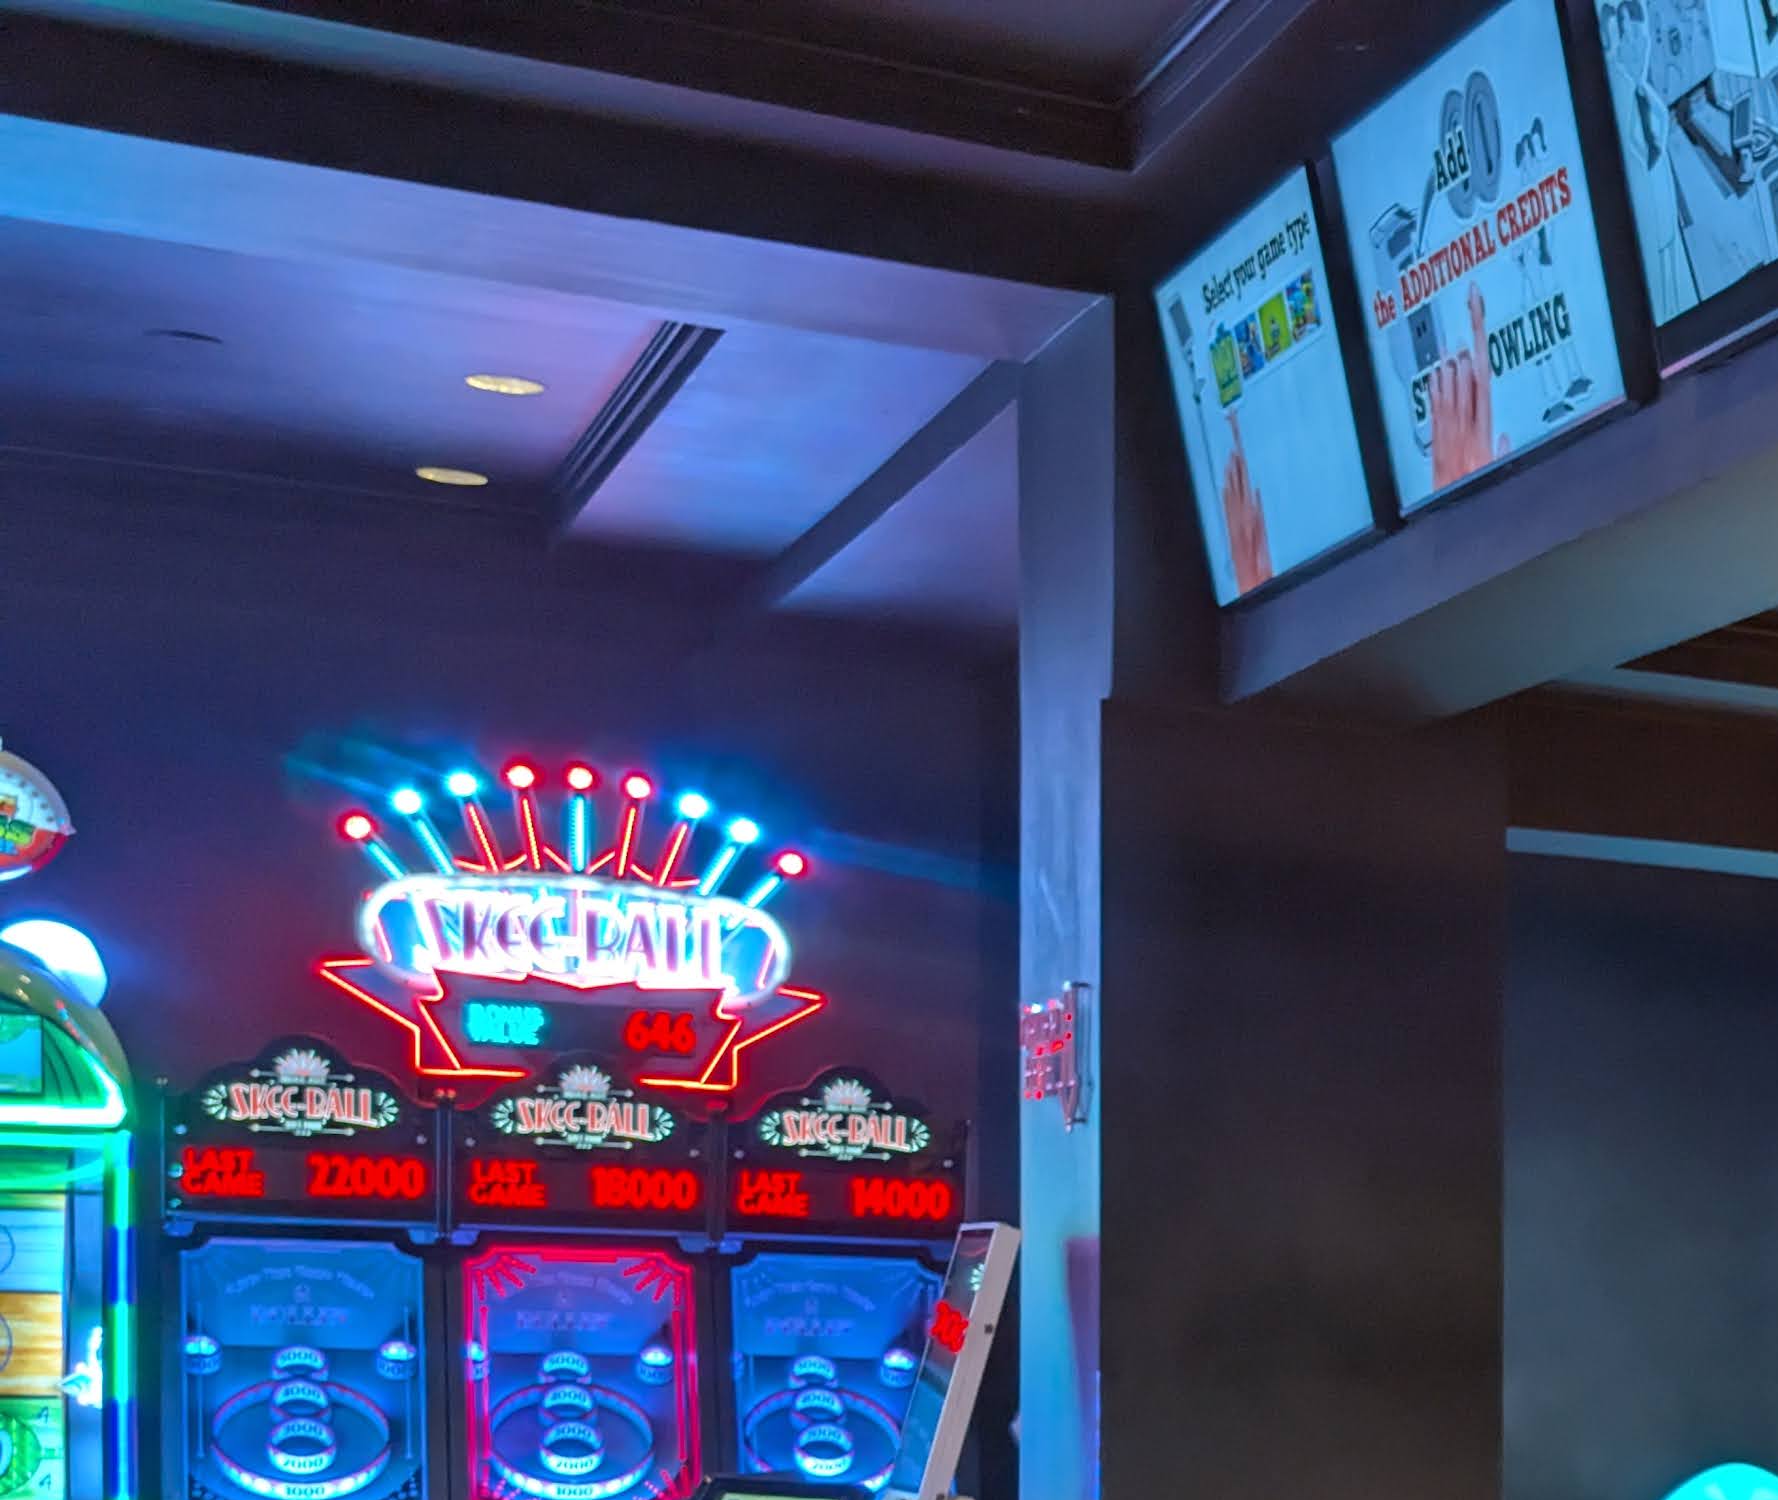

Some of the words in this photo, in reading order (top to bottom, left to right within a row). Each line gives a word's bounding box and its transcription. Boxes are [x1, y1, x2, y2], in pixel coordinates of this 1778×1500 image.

[1434, 130, 1468, 190] Add
[1202, 271, 1235, 315] Select
[1233, 255, 1256, 300] your
[1256, 231, 1287, 281] game
[1285, 211, 1310, 255] type
[1373, 290, 1397, 329] the
[1399, 219, 1497, 311] ADDITIONAL
[1496, 166, 1572, 247] CREDITS
[1487, 292, 1572, 378] OWLING
[625, 1009, 697, 1053] 646
[229, 1082, 381, 1128] SKEE-BALL
[515, 1097, 656, 1142] SKEE-BALL
[781, 1109, 914, 1153] SKEE-BALL
[184, 1147, 255, 1173] LAST
[306, 1153, 427, 1199] 22000
[471, 1159, 538, 1185] LAST
[181, 1170, 266, 1198] GAME
[468, 1182, 547, 1208] GAME
[591, 1165, 699, 1211] 18000
[737, 1191, 810, 1217] GAME
[740, 1170, 803, 1195] LAST
[852, 1177, 952, 1220] 14000
